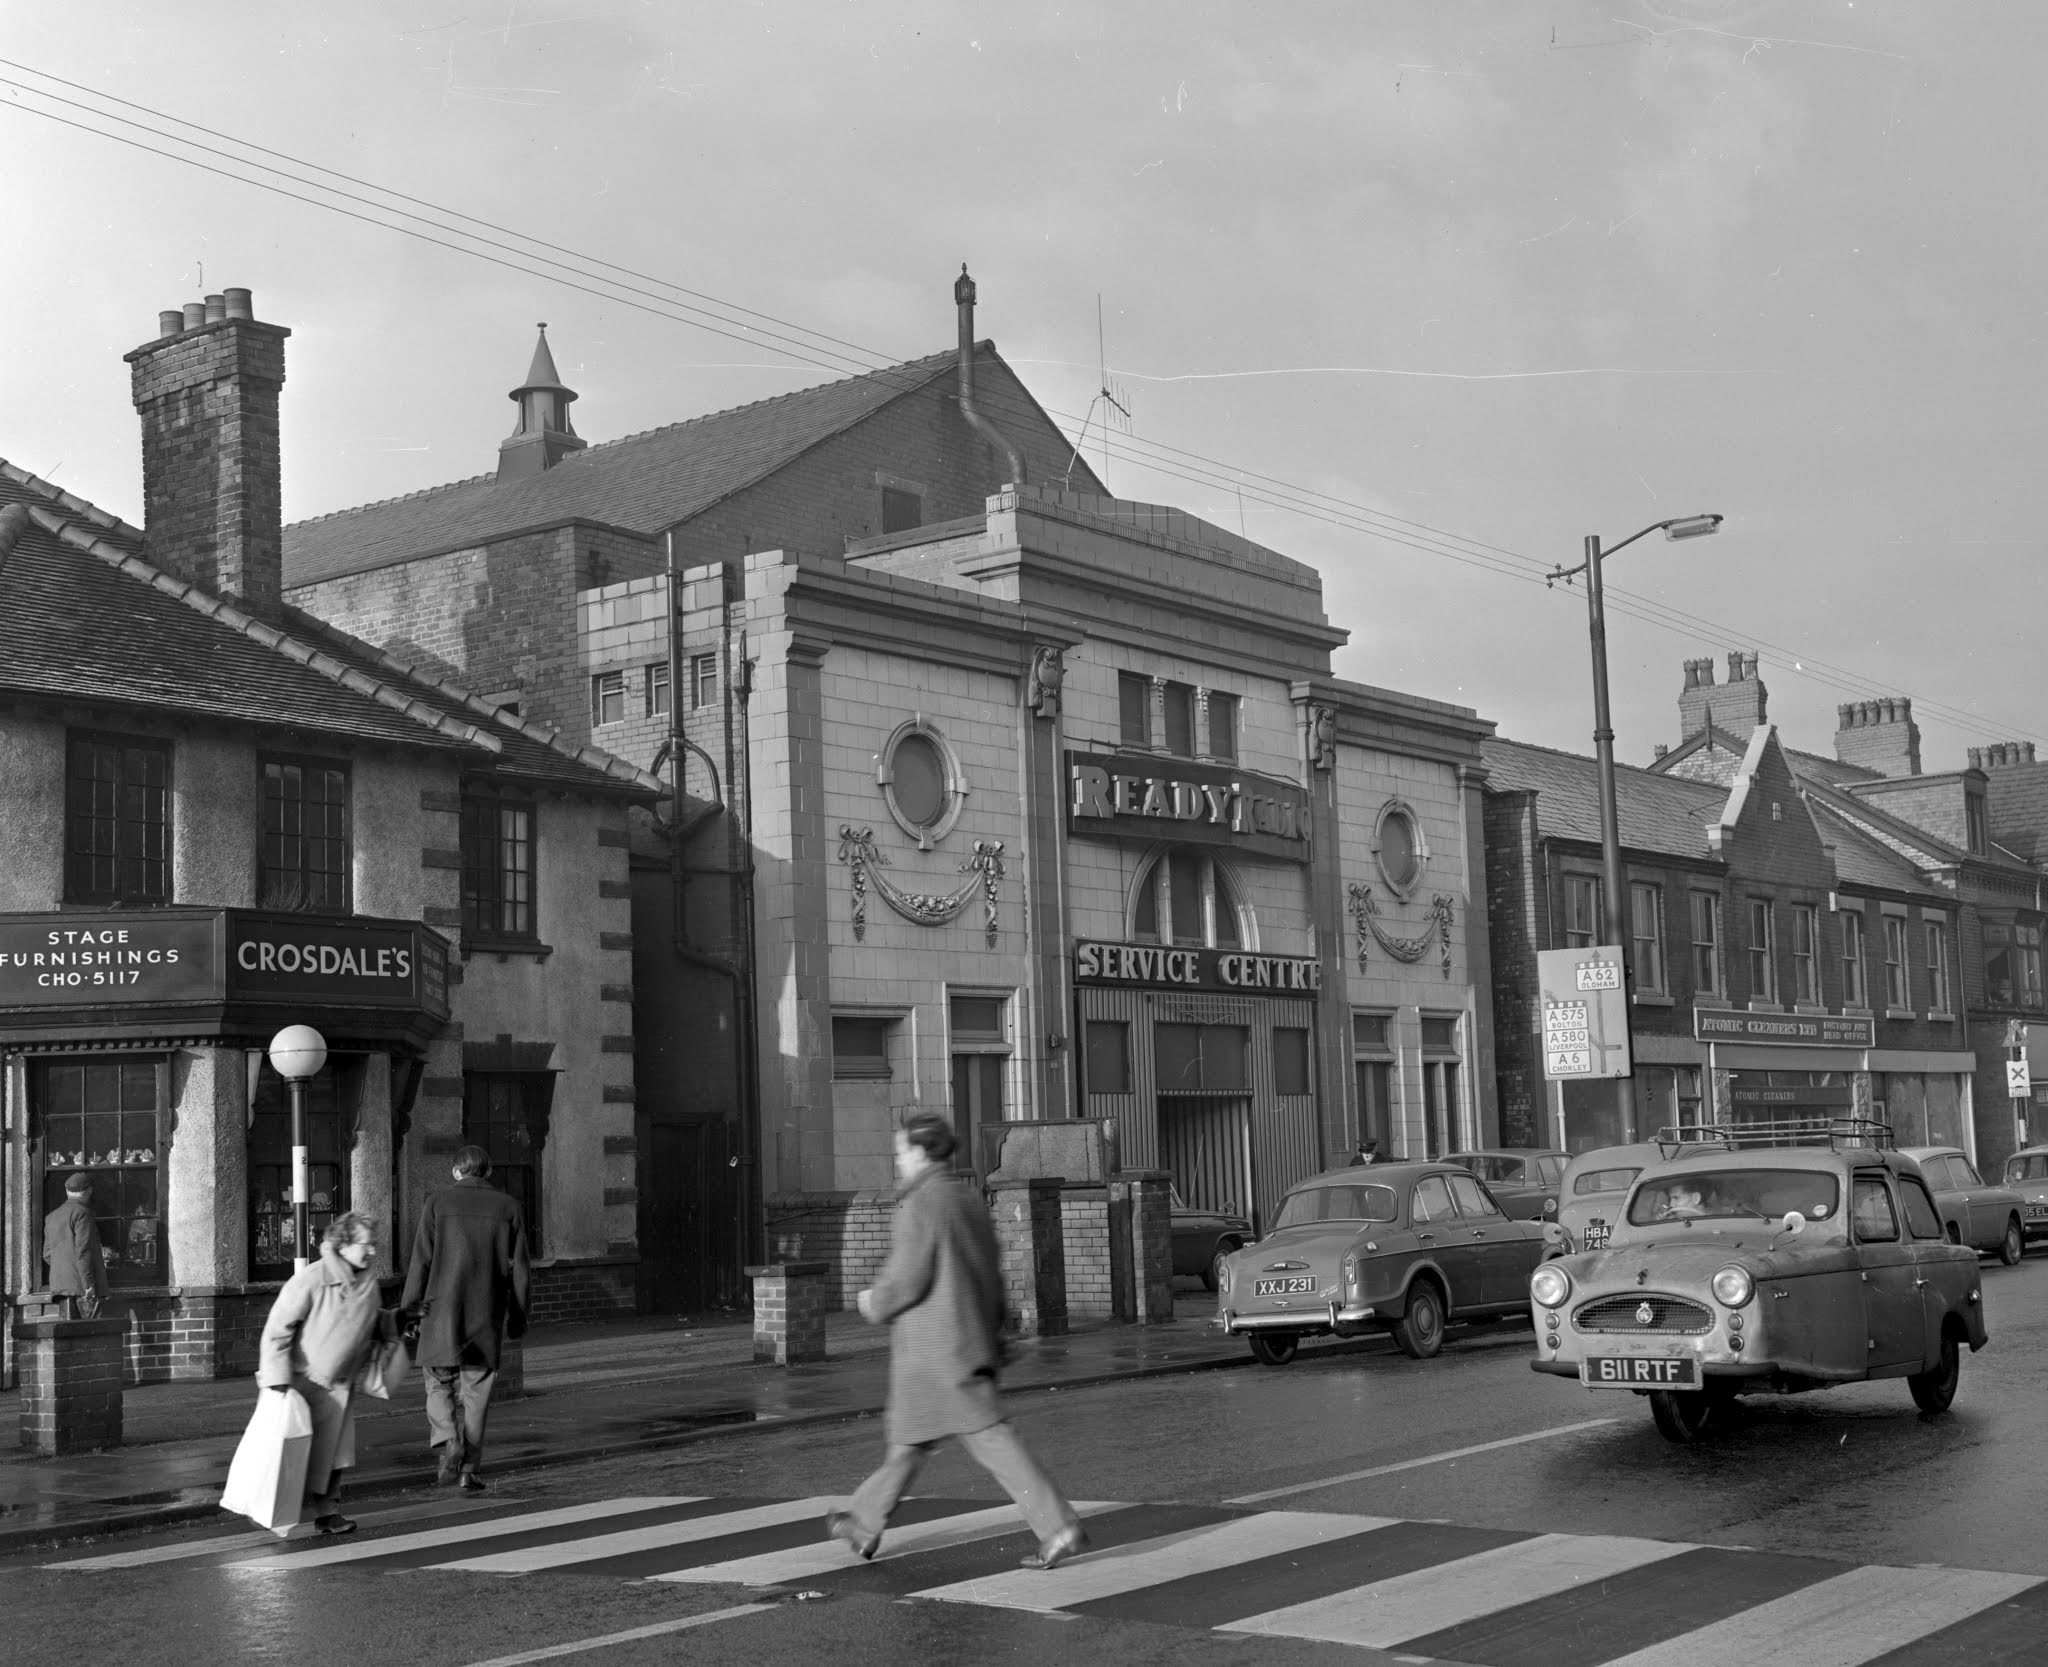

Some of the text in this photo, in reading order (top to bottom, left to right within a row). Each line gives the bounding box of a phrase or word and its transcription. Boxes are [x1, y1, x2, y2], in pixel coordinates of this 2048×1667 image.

[1073, 765, 1232, 823] READY
[48, 930, 129, 945] STAGE
[0, 949, 179, 967] FURNISHINGS
[237, 940, 411, 979] CROSDALE'S
[1078, 943, 1322, 990] SERVICE CENTRE
[1595, 968, 1613, 980] 62
[1581, 980, 1615, 989] OLDHAM
[1561, 1009, 1584, 1021] 575
[1551, 1021, 1583, 1029] BOLTON
[1702, 1018, 1817, 1036] ATOMIC CLEANERS LTD
[1561, 1030, 1586, 1042] 580
[1549, 1042, 1587, 1051] LIVERPOOL
[1572, 1052, 1580, 1063] 6
[1552, 1064, 1587, 1073] CHORLEY
[1735, 1091, 1795, 1100] ATOMIC CLEANERS
[301, 1156, 307, 1165] 2
[1585, 1226, 1609, 1239] HBA
[1585, 1238, 1609, 1250] 748
[1259, 1280, 1286, 1295] XXJ
[1288, 1277, 1312, 1292] 231
[1600, 1359, 1681, 1381] 611 RTF
